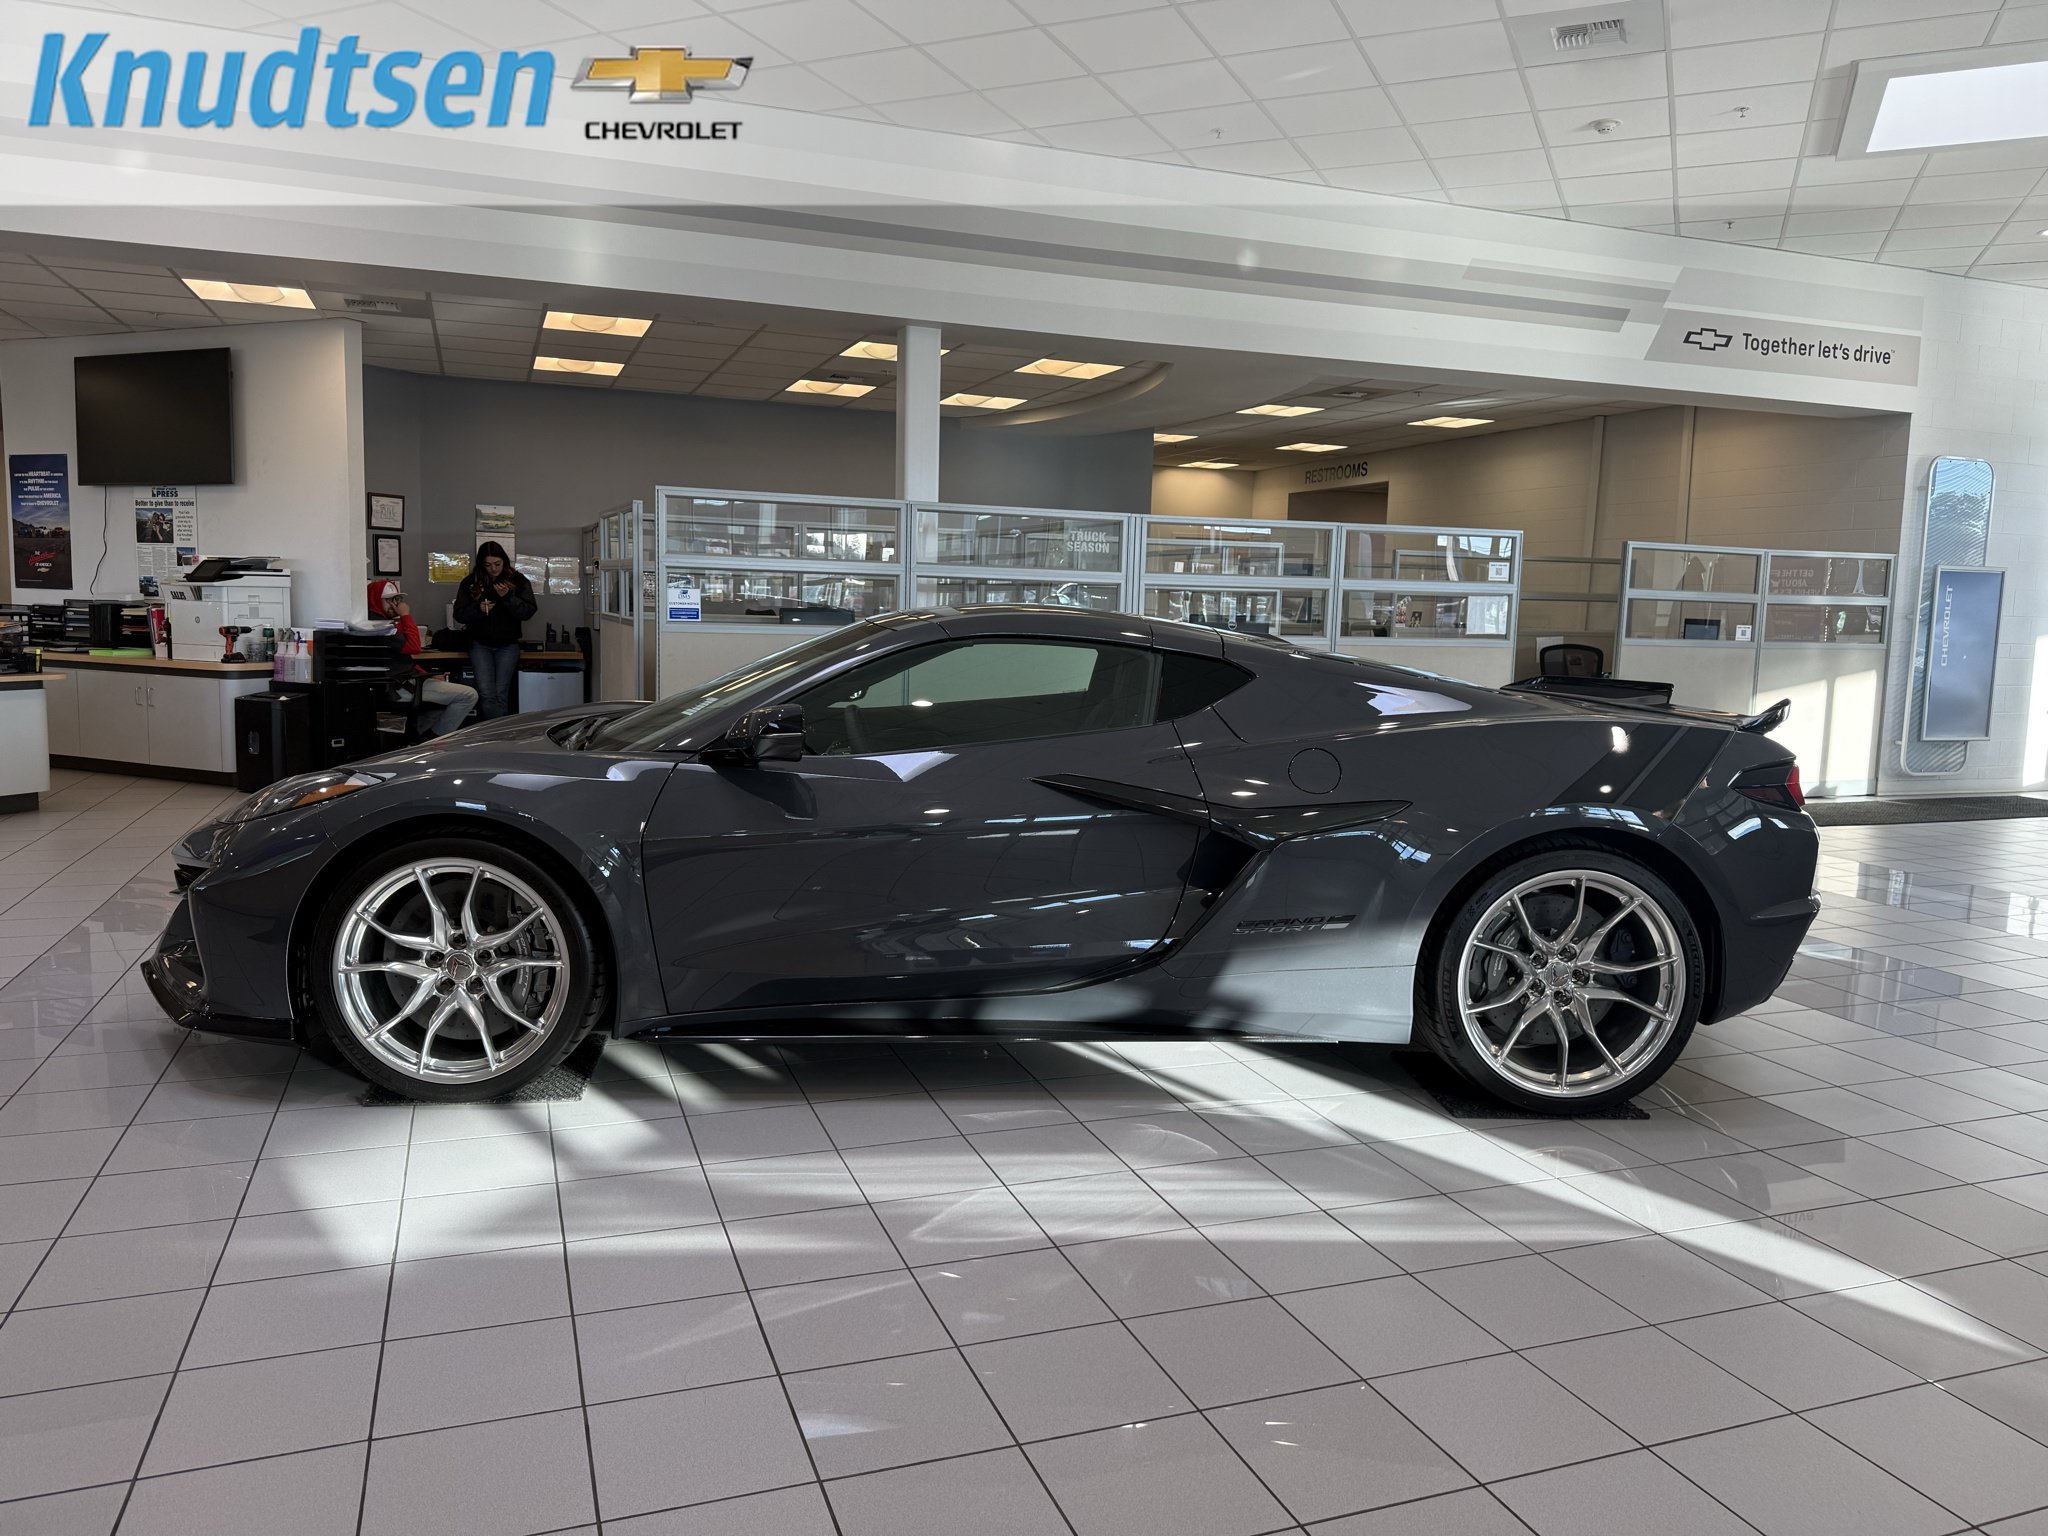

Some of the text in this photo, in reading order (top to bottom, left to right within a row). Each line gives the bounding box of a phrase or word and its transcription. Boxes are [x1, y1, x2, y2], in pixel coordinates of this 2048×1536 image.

[1742, 333, 1815, 357] Together
[1818, 340, 1850, 360] let's
[1305, 461, 1368, 484] RESTROOMS
[156, 490, 178, 498] PRESS
[1070, 530, 1107, 542] TRUCK
[1067, 541, 1110, 553] SEASON
[1941, 585, 1953, 666] CHEVROLET
[1236, 916, 1326, 927] GRAND
[1232, 924, 1321, 934] SPORT
